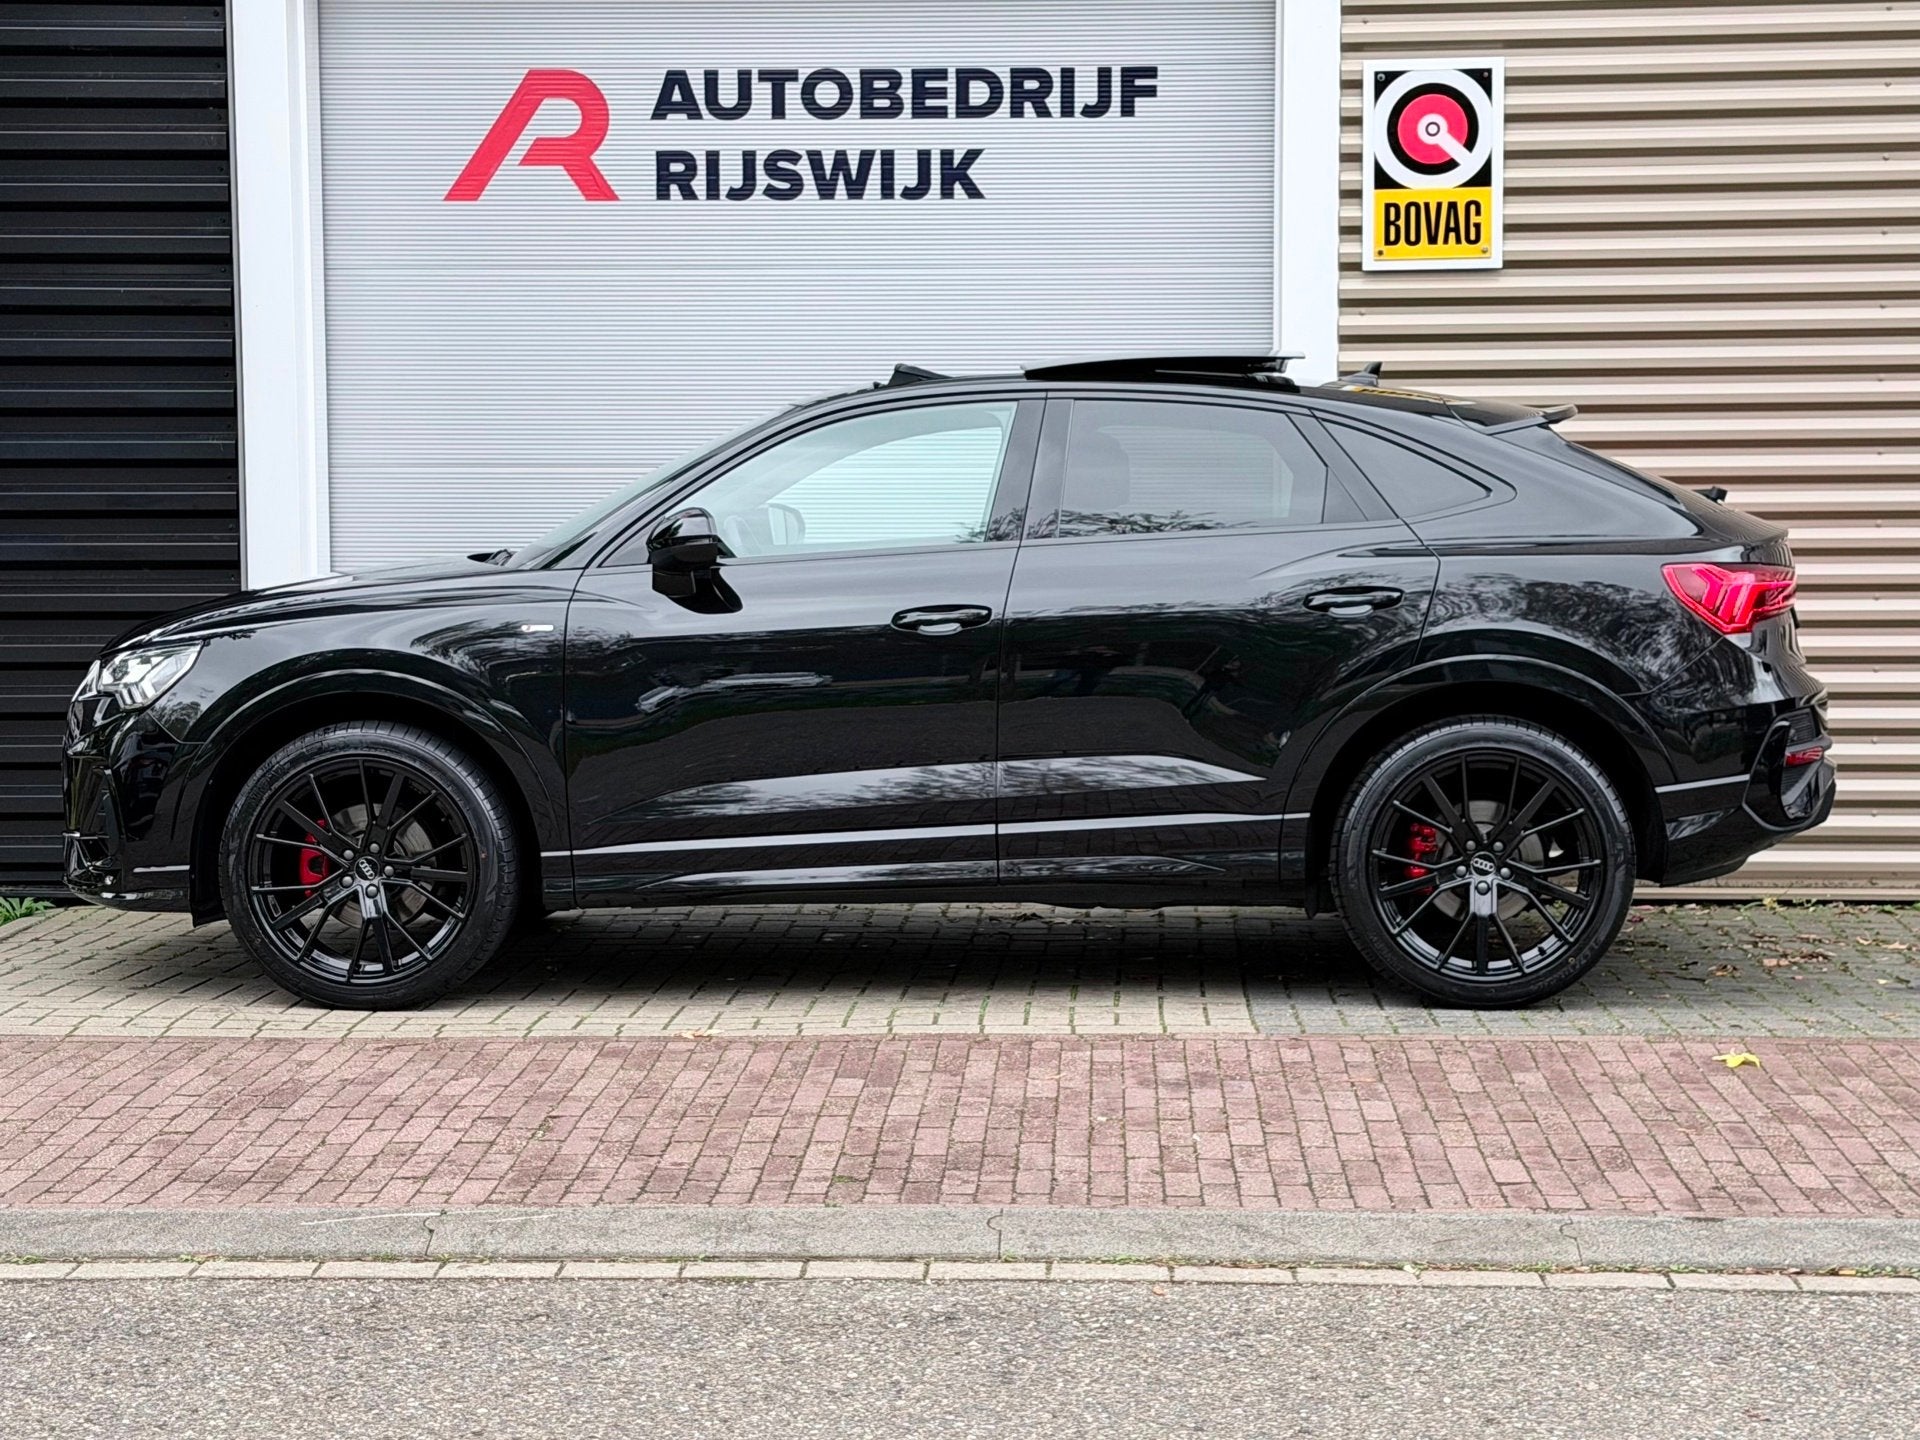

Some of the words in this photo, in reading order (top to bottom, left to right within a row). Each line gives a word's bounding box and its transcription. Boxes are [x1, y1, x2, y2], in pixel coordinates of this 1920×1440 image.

[651, 66, 1158, 120] AUTOBEDRIJF
[655, 149, 985, 201] RIJSWIJK
[1384, 200, 1481, 246] BOVAG
